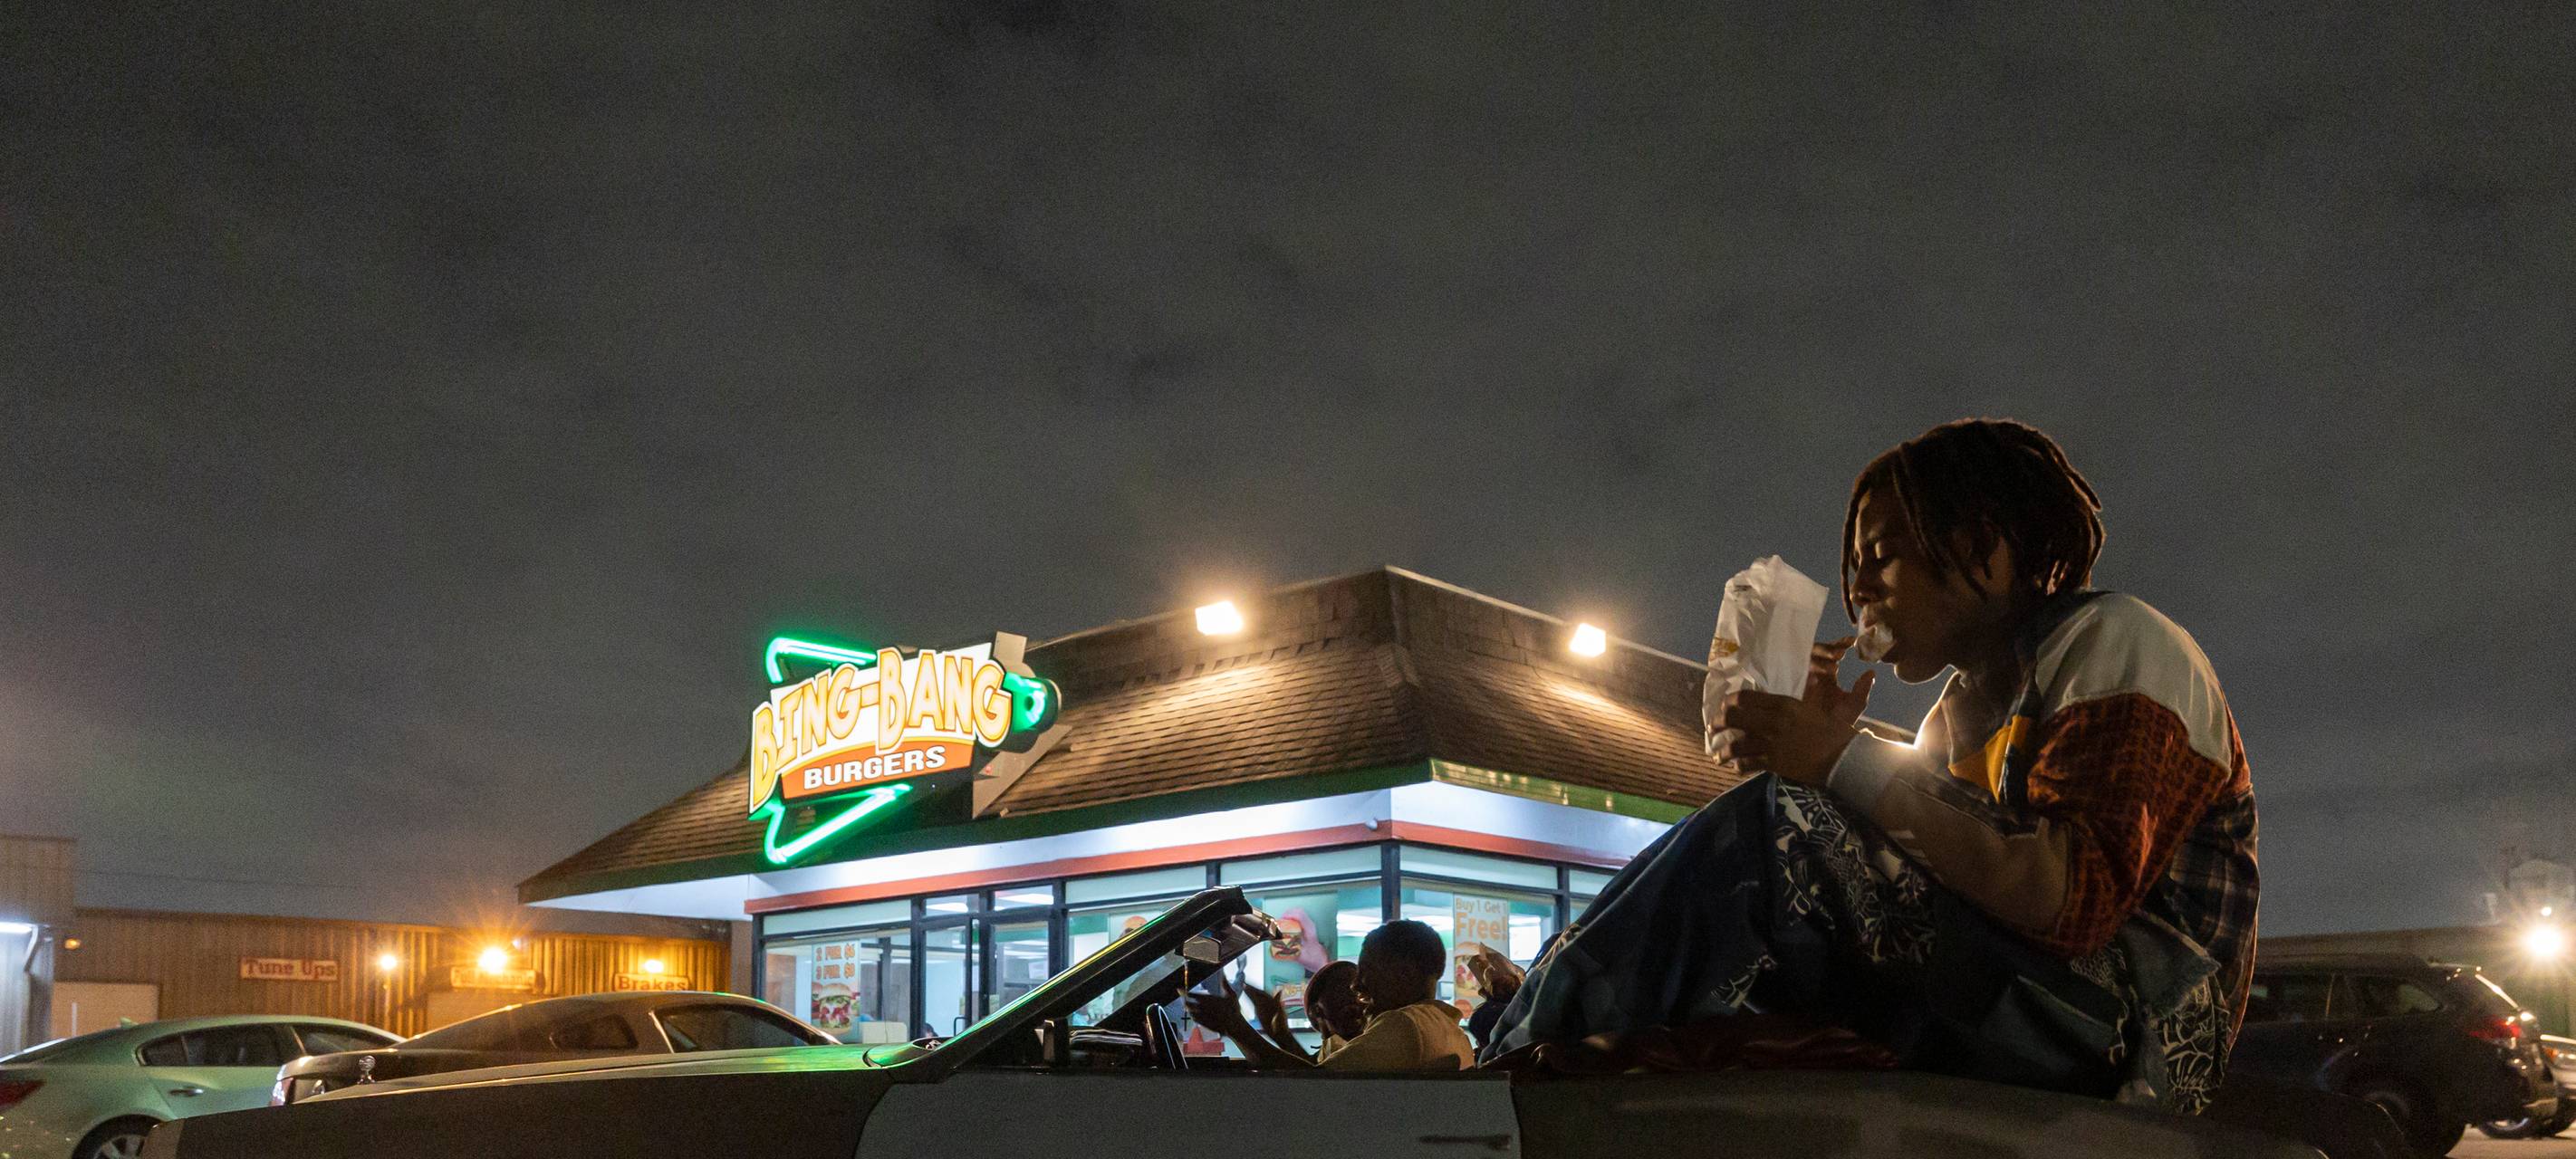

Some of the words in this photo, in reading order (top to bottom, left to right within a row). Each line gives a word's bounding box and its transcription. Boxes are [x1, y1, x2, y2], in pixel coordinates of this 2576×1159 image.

[752, 648, 1012, 808] BING-BANG
[803, 746, 946, 790] BURGERS
[1456, 897, 1475, 913] Buy
[1485, 901, 1501, 914] Get
[1456, 912, 1508, 941] Free!
[245, 960, 293, 975] Tune
[302, 960, 335, 979] Ups
[617, 975, 686, 991] Brakes
